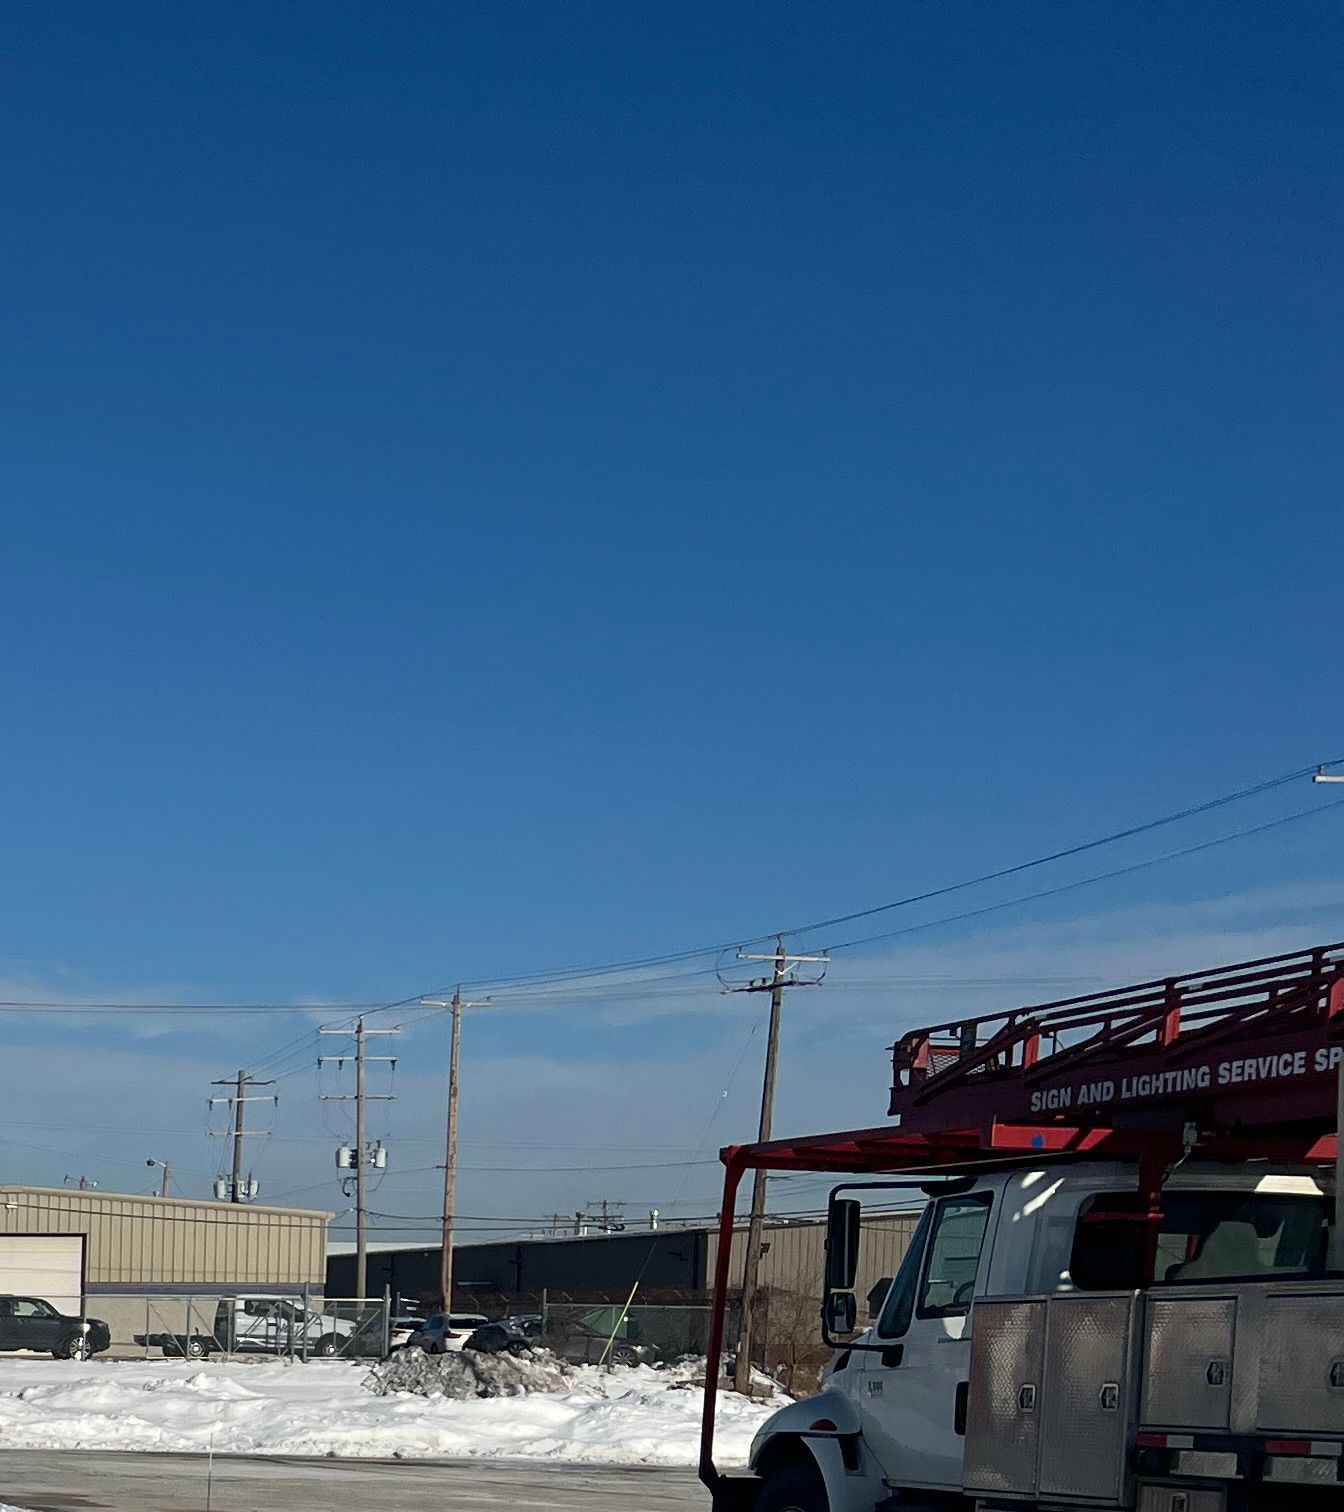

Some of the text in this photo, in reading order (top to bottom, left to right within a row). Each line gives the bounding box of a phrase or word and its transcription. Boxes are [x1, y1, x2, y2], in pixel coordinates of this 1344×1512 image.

[1030, 1086, 1073, 1113] SIGN
[1077, 1080, 1115, 1106] AND
[1121, 1065, 1211, 1099] LIGHTING
[1217, 1051, 1307, 1085] SERVICE
